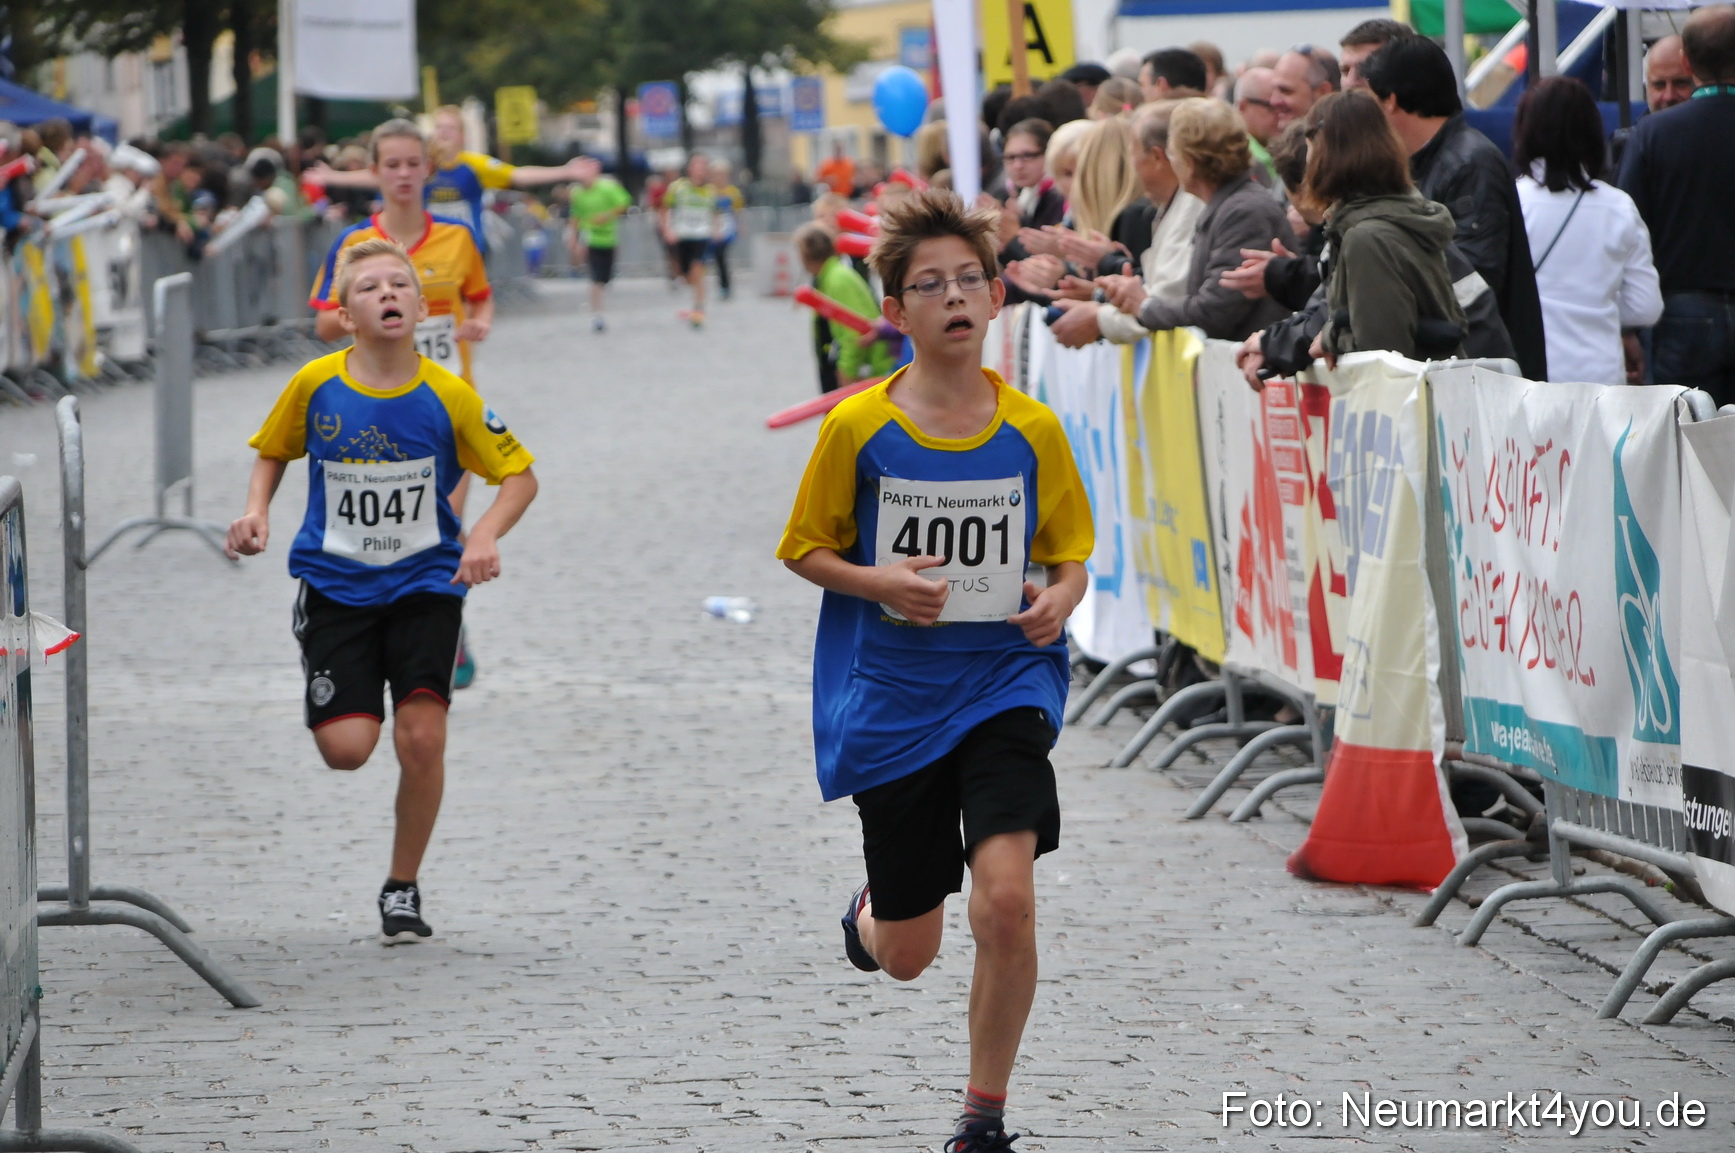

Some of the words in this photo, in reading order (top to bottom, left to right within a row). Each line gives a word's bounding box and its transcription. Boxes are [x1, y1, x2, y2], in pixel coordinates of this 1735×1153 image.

[327, 472, 361, 484] PARTL
[364, 472, 418, 484] Neumarkt
[338, 485, 425, 527] 4047
[883, 491, 933, 508] PARTL
[938, 495, 1005, 508] Neumarkt
[363, 537, 401, 552] Philp
[892, 514, 1009, 567] 4001
